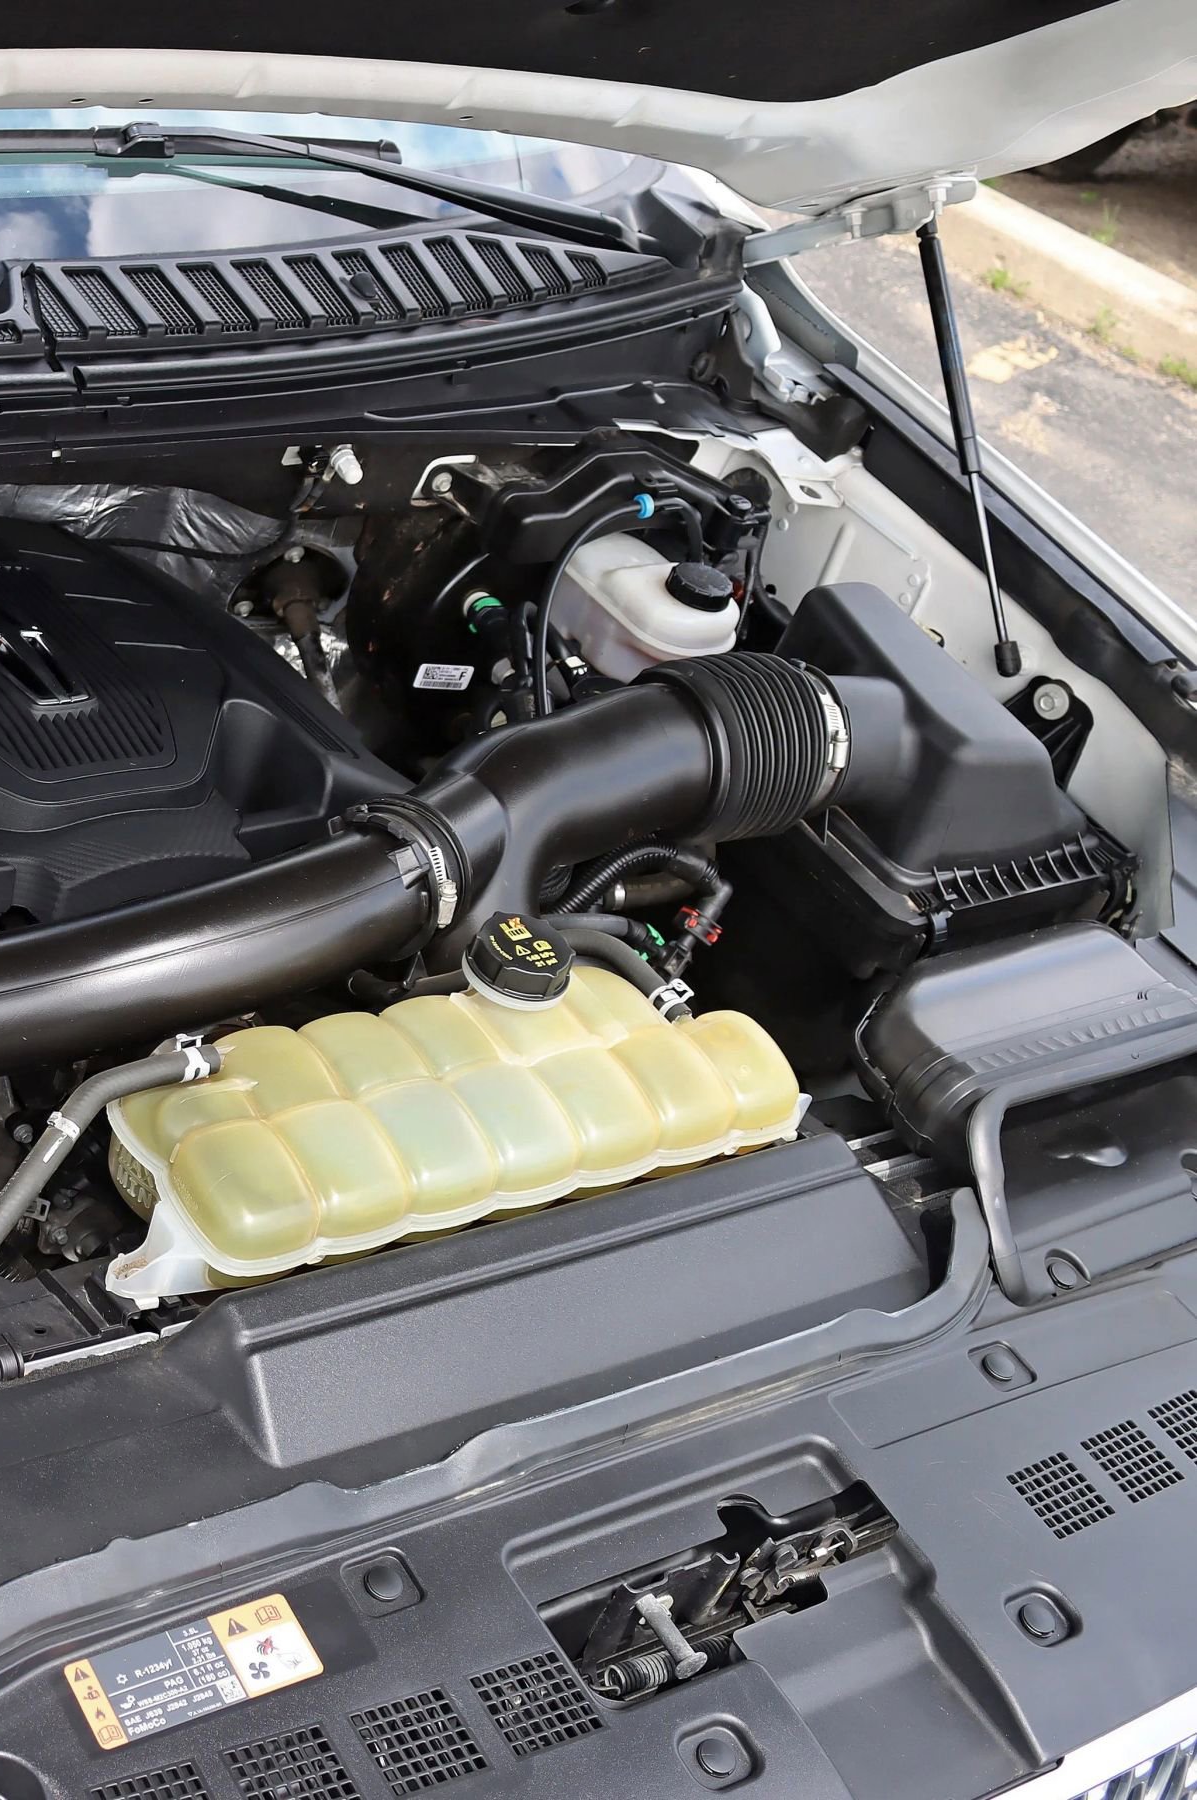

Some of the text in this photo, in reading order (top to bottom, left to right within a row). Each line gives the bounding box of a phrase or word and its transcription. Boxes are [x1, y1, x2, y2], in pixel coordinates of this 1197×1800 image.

[117, 1164, 154, 1209] MIN
[201, 1637, 213, 1645] kg
[192, 1648, 199, 1656] 37
[134, 1658, 172, 1678] R-1234yf
[217, 1668, 230, 1678] cc)
[164, 1676, 184, 1688] PAG
[127, 1718, 166, 1736] FoMoCo
